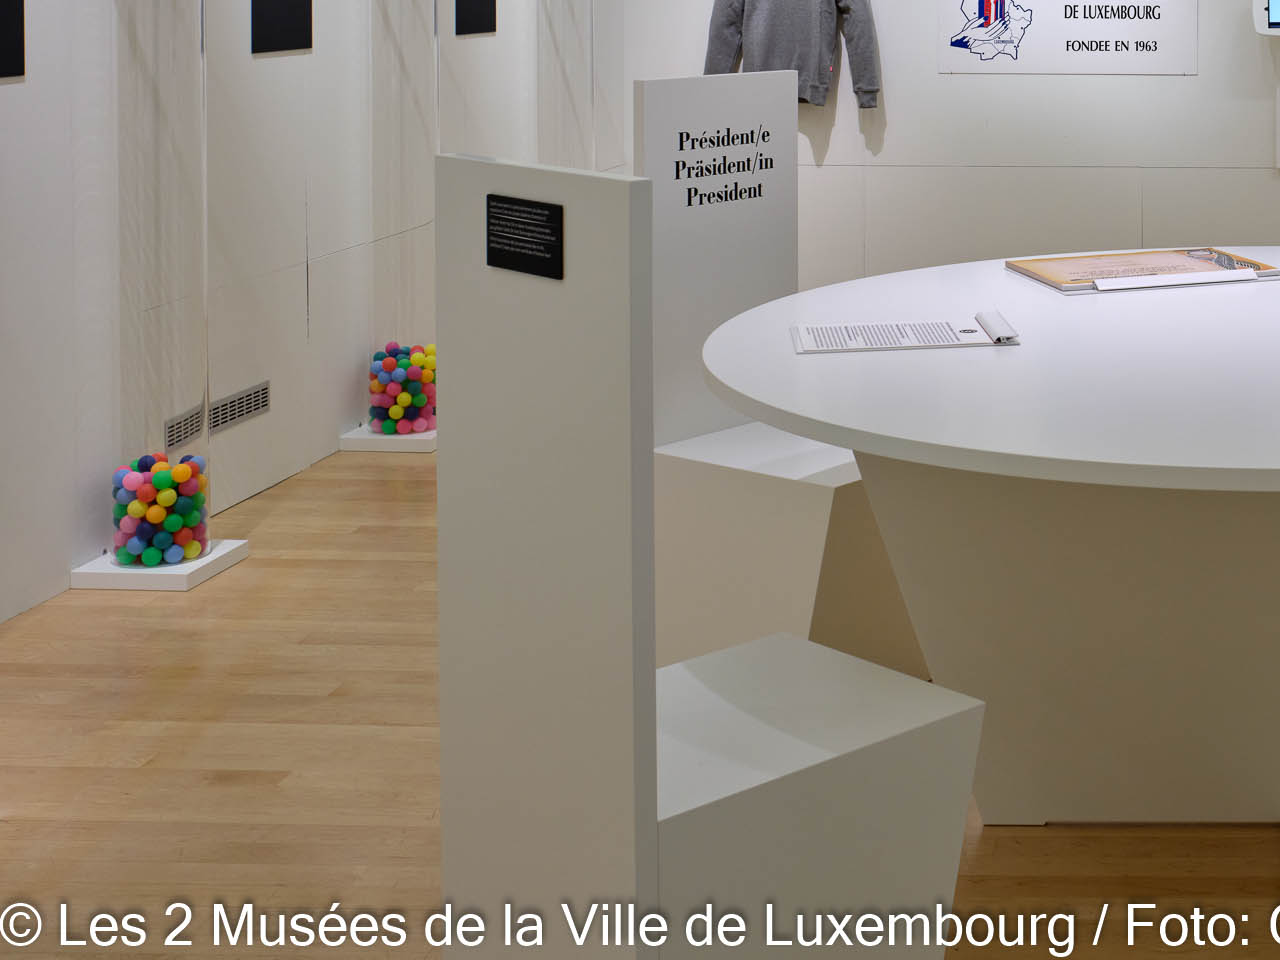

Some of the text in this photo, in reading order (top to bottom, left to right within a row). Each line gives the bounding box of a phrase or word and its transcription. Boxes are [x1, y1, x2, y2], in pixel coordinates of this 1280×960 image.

[1064, 5, 1161, 20] DE LUXEMBOURG
[1066, 40, 1158, 52] FONDEE EN 1963
[678, 124, 770, 151] Président/e
[674, 152, 773, 180] Präsident/in
[686, 182, 763, 207] President
